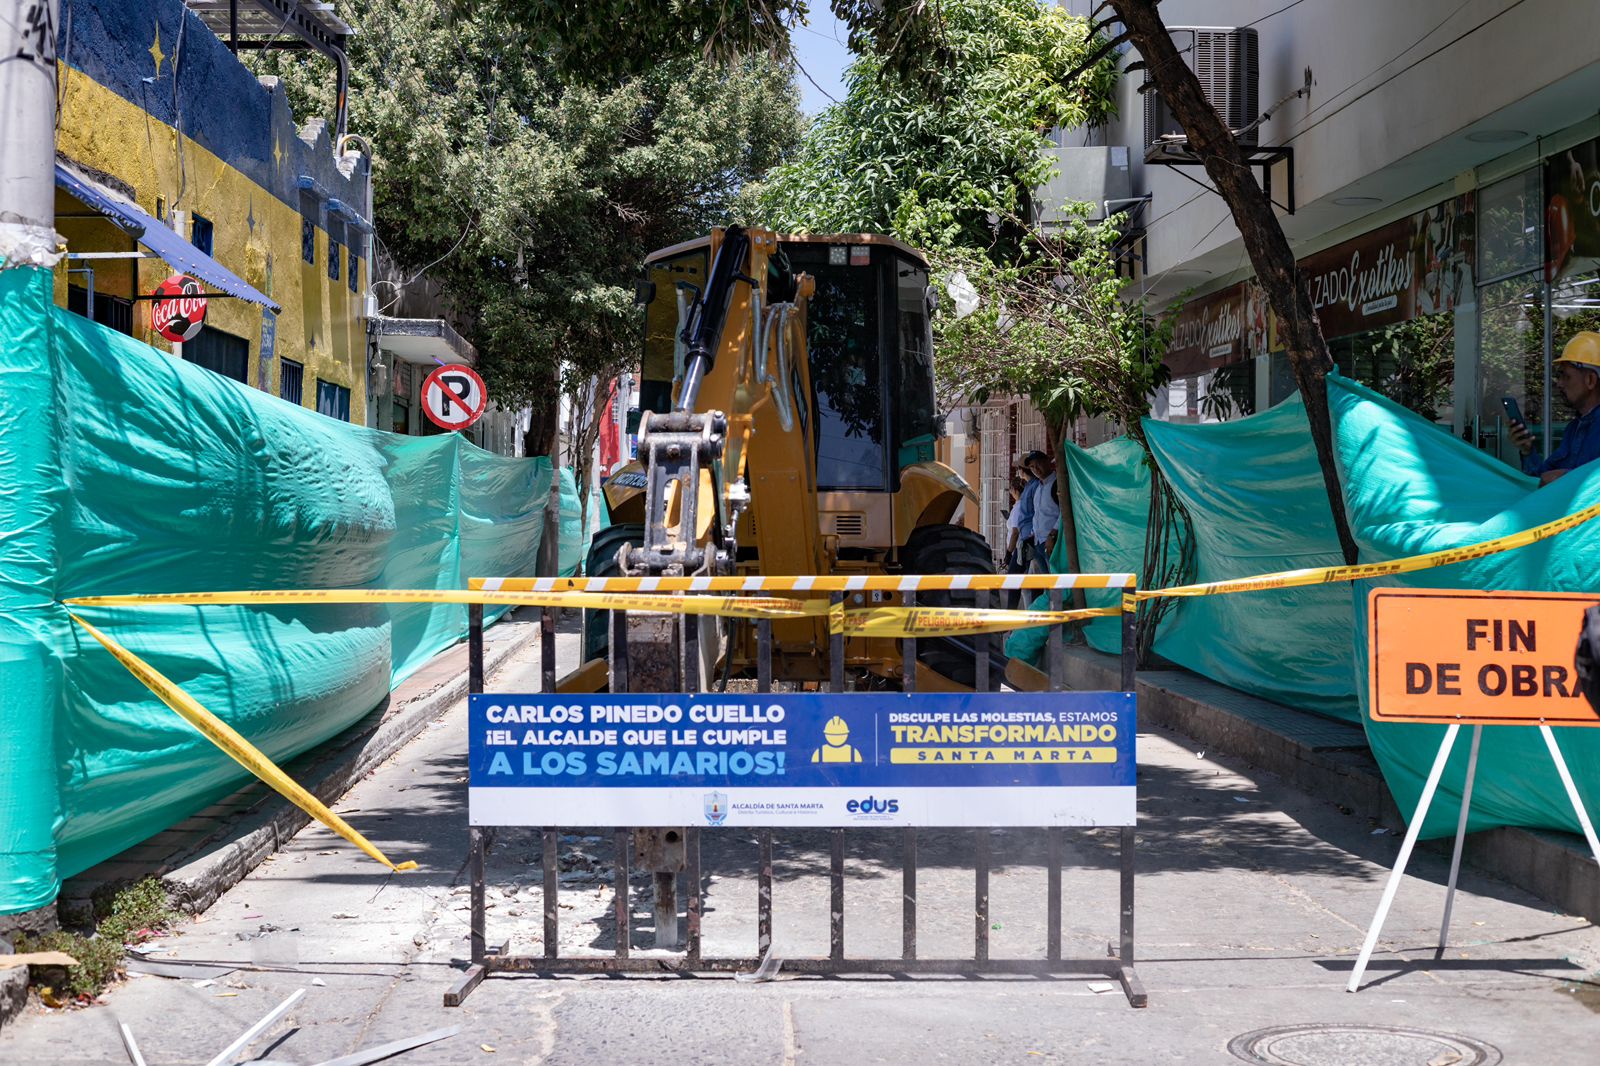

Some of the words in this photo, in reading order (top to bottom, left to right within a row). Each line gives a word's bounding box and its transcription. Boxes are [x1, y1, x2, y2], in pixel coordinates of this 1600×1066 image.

[1466, 618, 1537, 652] FIN
[1405, 662, 1462, 695] DE
[485, 704, 584, 724] CARLOS
[590, 704, 683, 724] PINEDO
[689, 704, 785, 724] CUELLO
[888, 712, 951, 723] DISCULPE
[953, 712, 979, 723] LAS
[981, 712, 1056, 724] MOLESTIAS,
[1059, 711, 1118, 722] ESTAMOS
[522, 730, 617, 746] ALCALDE
[622, 730, 666, 747] QUE
[671, 730, 697, 746] LE
[702, 730, 787, 746] CUMPLE
[890, 724, 1117, 744] TRANSFORMANDO
[487, 752, 514, 776] A
[522, 752, 588, 776] LOS
[596, 752, 786, 776] SAMARIOS!
[917, 751, 995, 761] SANTA
[1014, 750, 1093, 761] MARTA
[846, 795, 899, 814] edus
